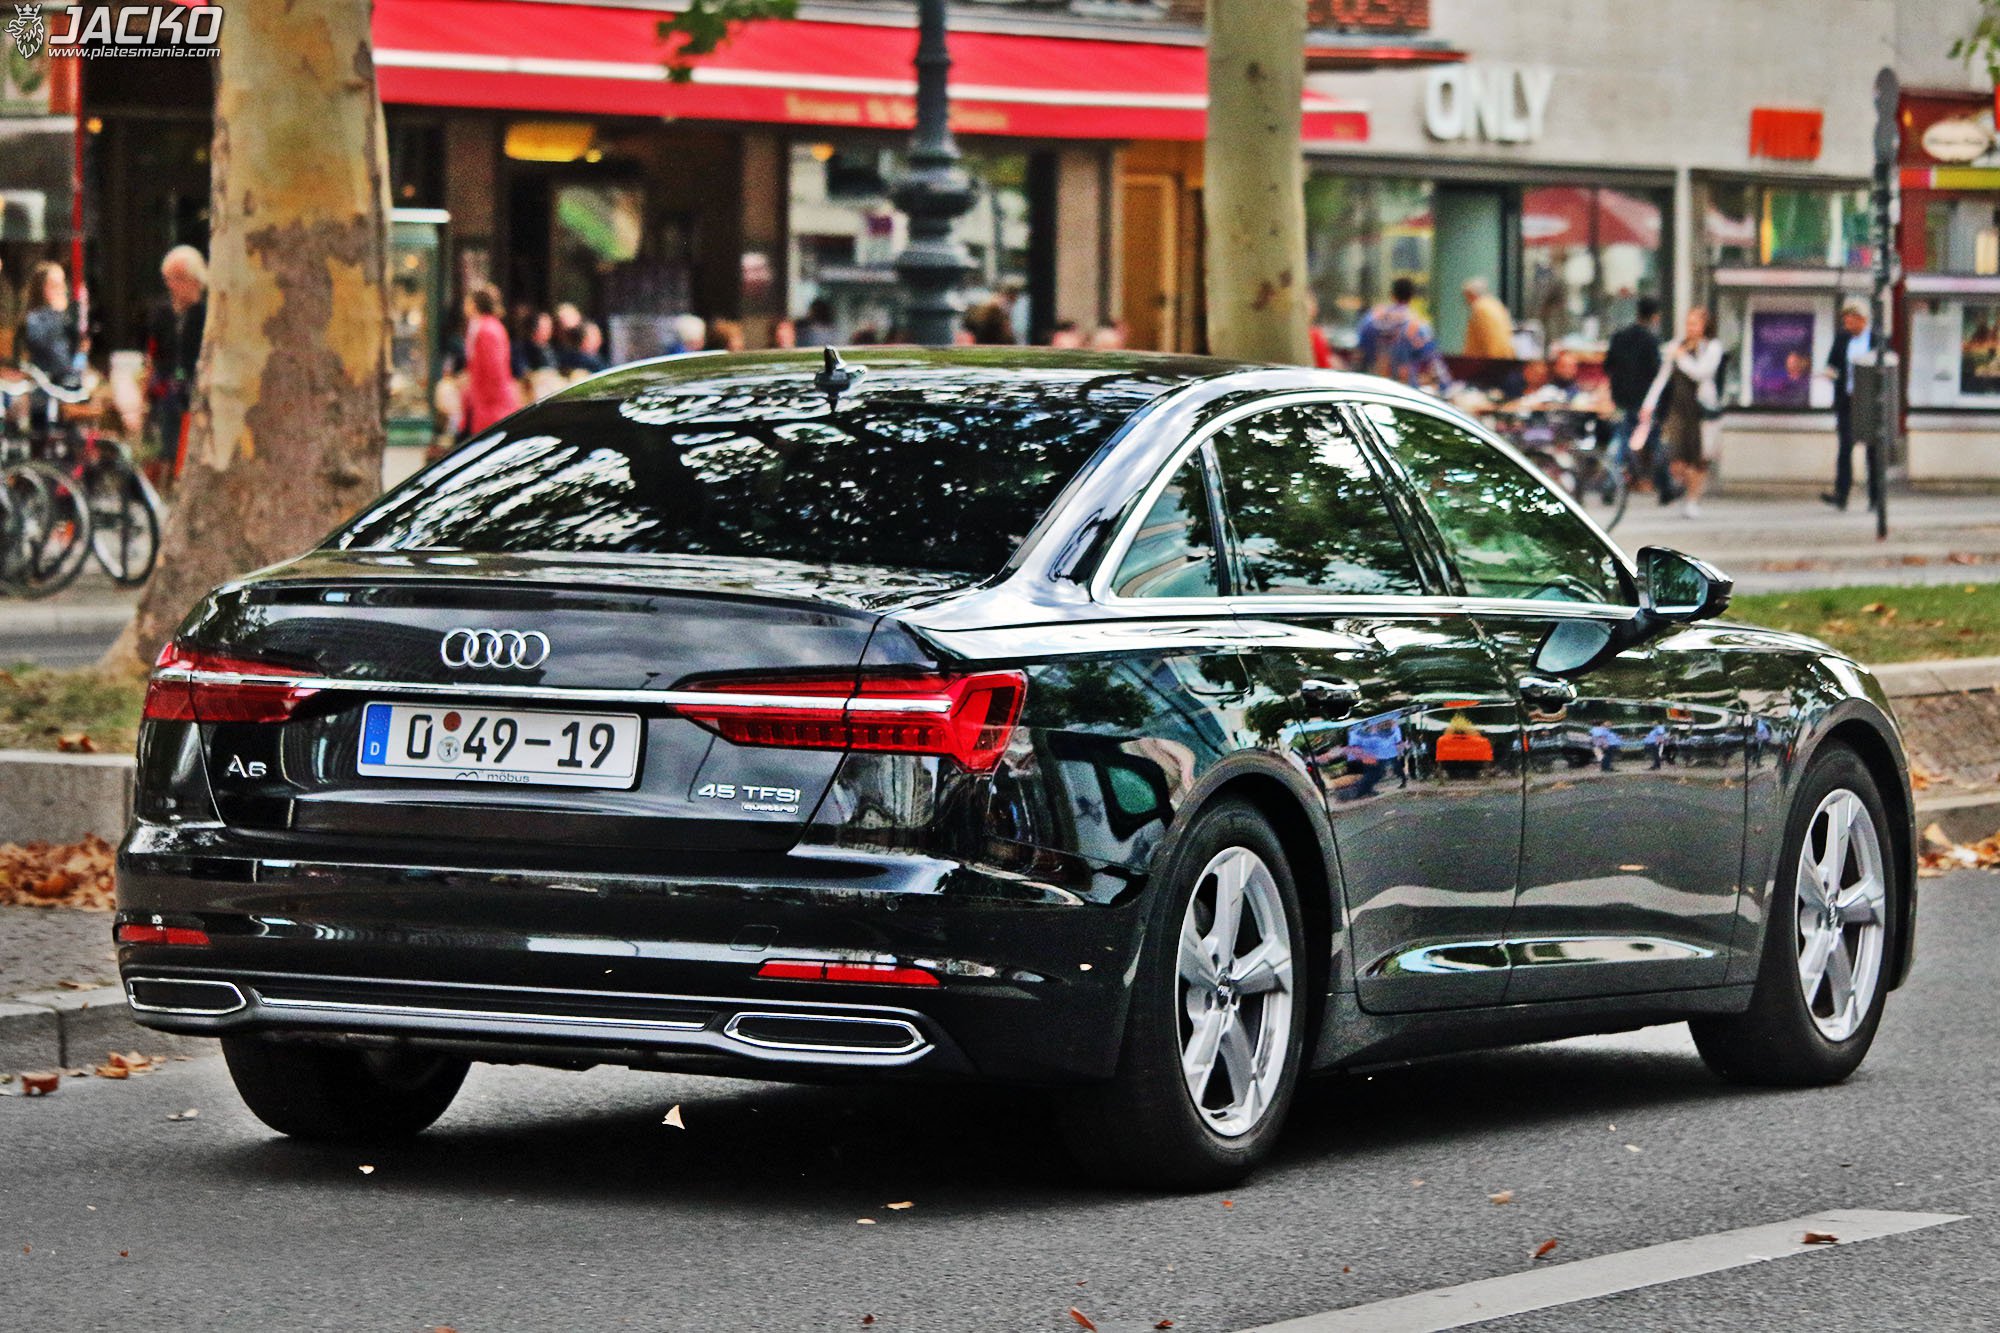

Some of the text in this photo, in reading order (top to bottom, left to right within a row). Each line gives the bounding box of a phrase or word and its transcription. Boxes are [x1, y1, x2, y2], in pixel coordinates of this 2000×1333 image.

[1425, 65, 1554, 141] ONLY
[370, 742, 380, 756] D
[224, 754, 267, 778] A6
[487, 770, 530, 783] möbus
[698, 783, 801, 803] 45 TFSI
